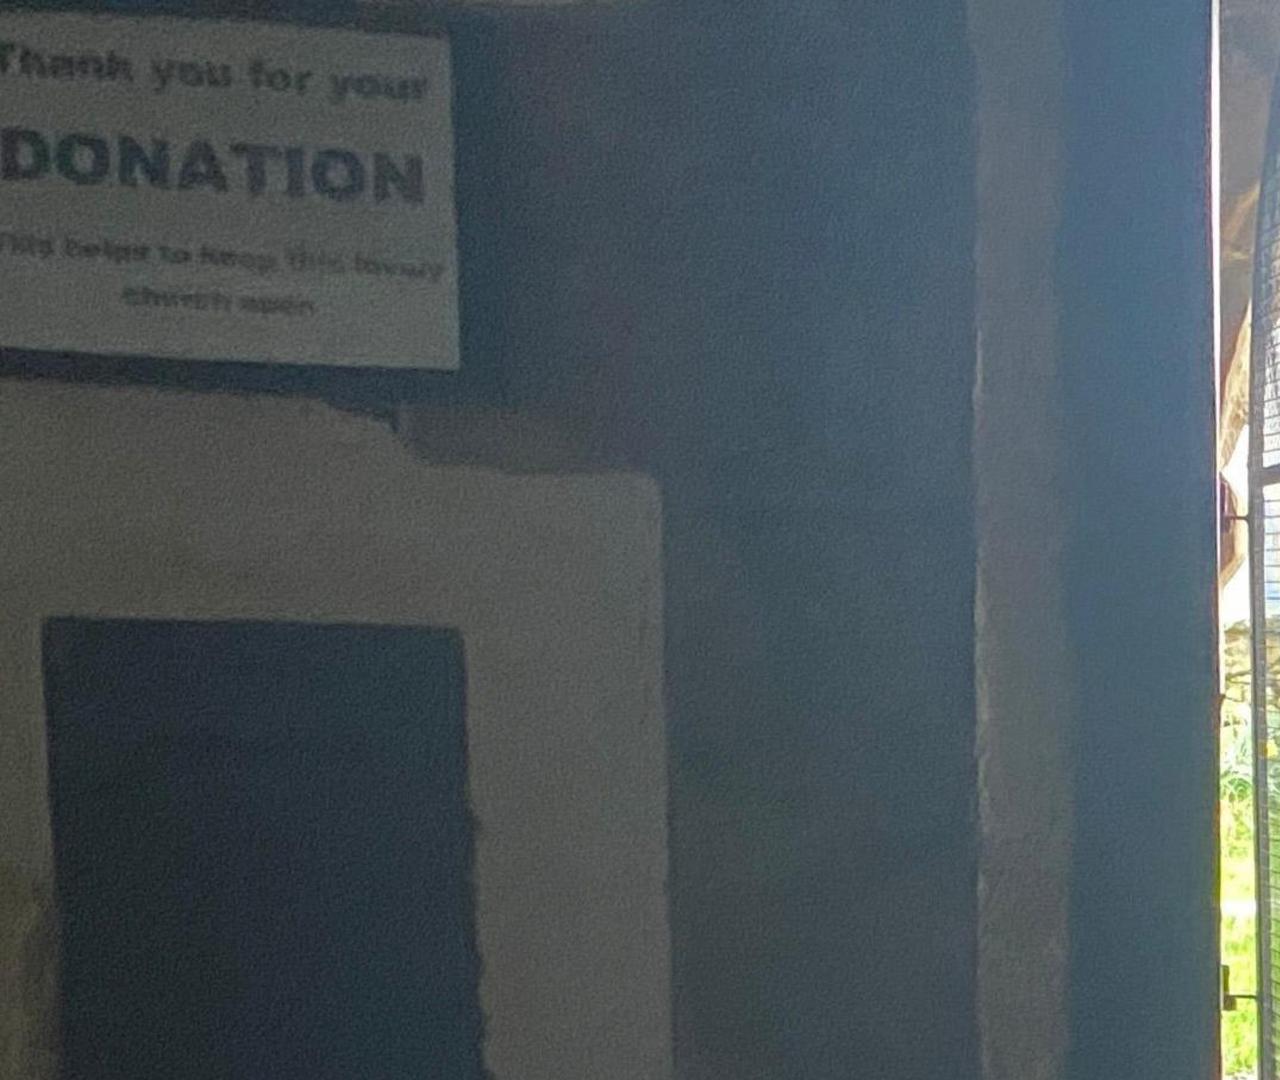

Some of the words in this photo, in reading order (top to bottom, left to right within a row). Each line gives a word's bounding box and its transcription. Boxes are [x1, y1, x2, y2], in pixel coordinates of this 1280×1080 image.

[150, 58, 232, 96] you
[248, 57, 313, 97] for
[329, 73, 428, 106] your
[1, 126, 427, 205] DONATION
[64, 237, 150, 266] helps
[158, 244, 192, 265] to
[199, 244, 278, 275] keep
[283, 243, 346, 273] this
[239, 294, 317, 319] open
